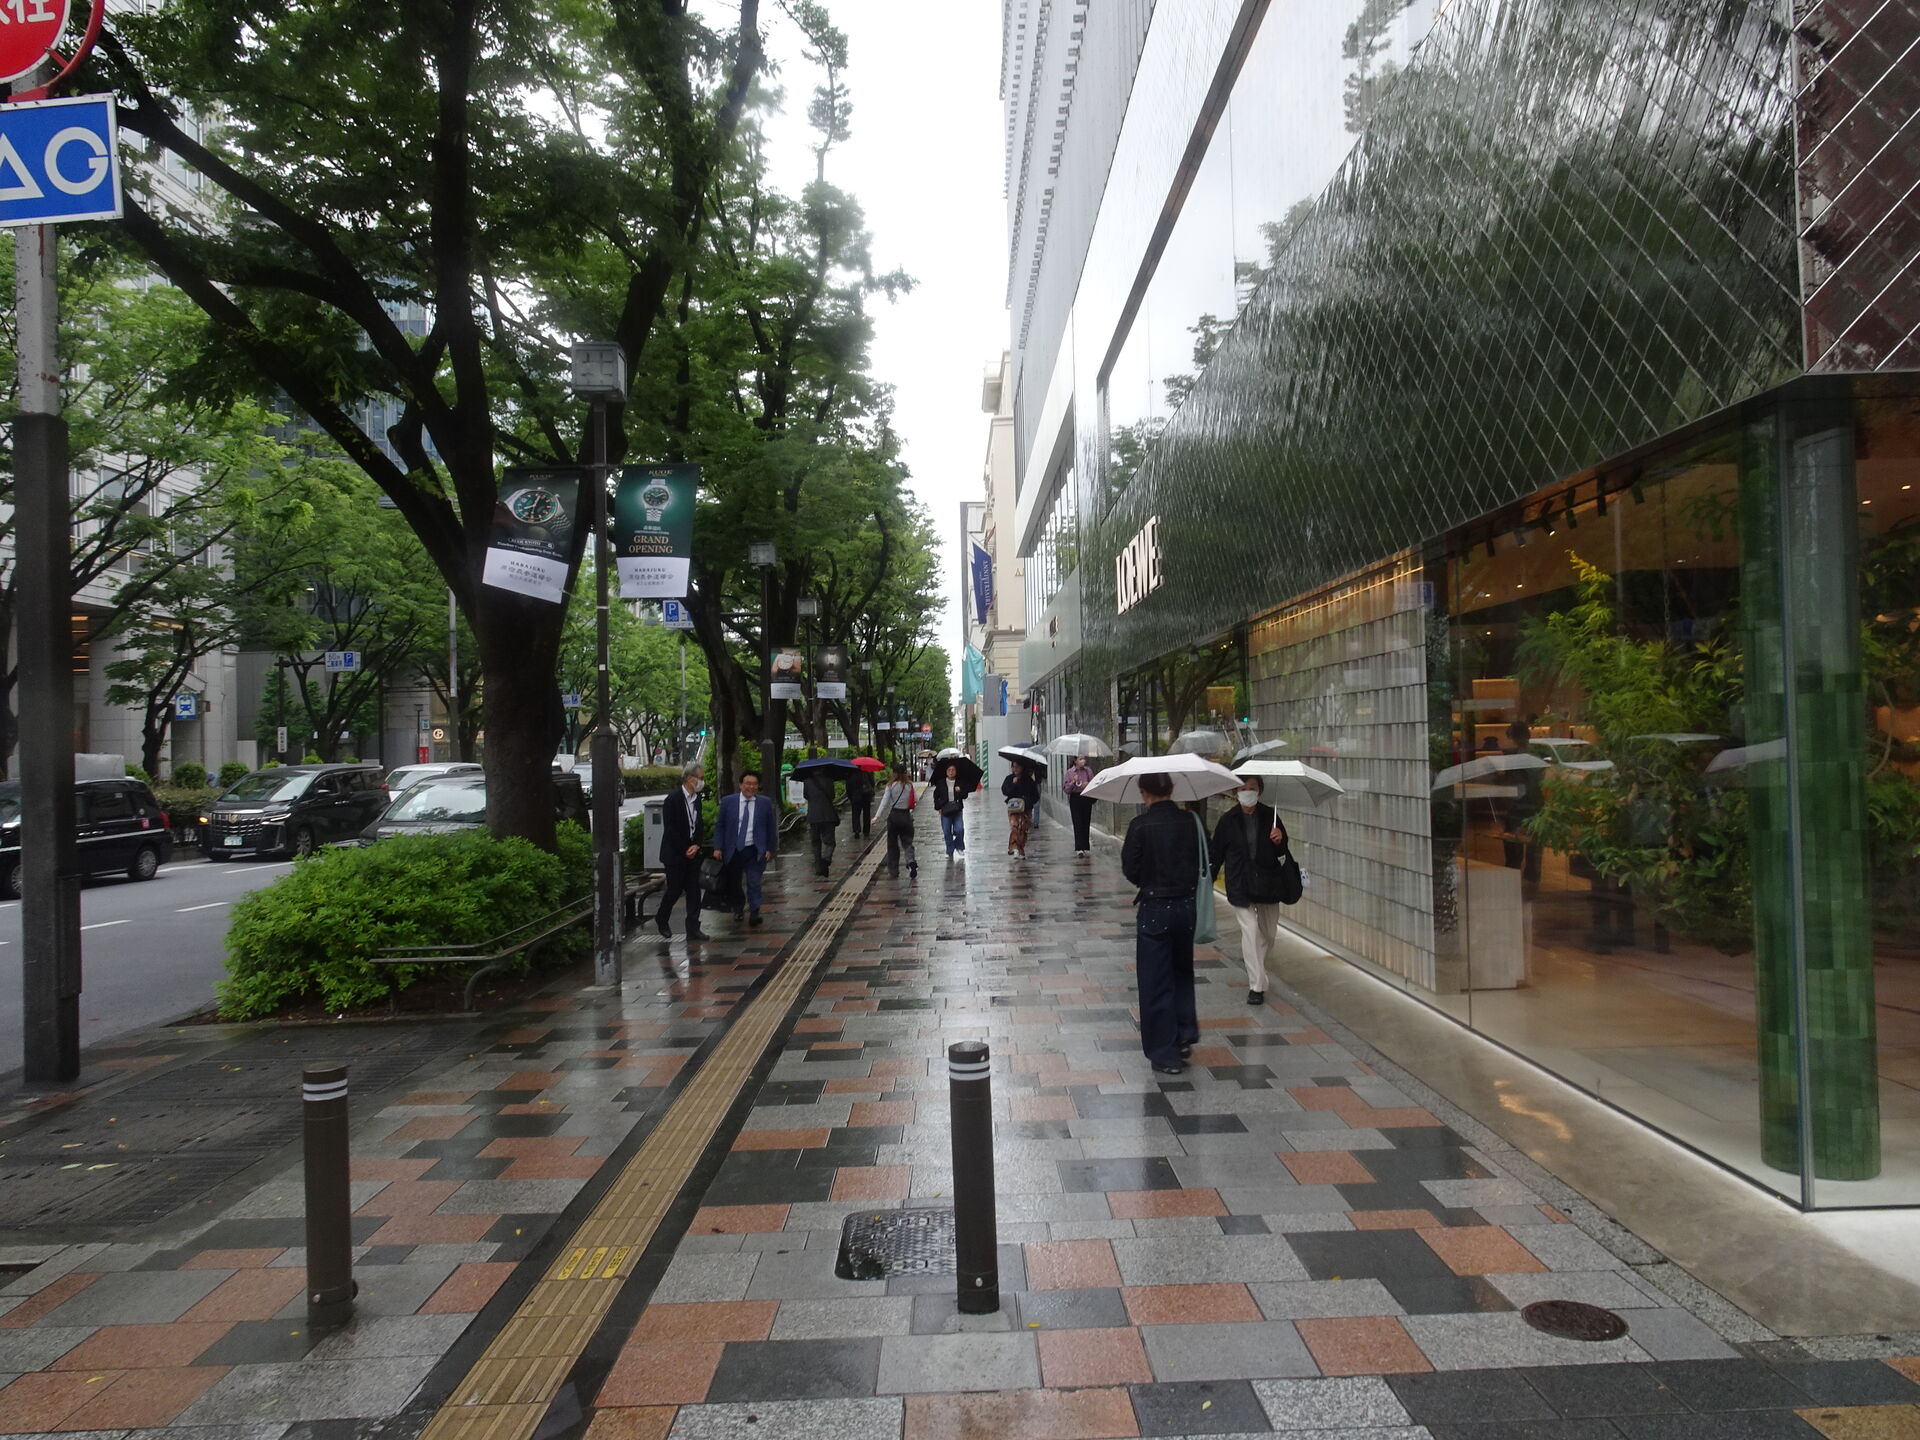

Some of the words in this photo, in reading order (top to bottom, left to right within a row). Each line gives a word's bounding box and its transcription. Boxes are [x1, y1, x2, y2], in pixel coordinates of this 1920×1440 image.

[633, 535, 669, 544] GRAND
[628, 544, 673, 554] OPENING
[1116, 516, 1160, 615] LOEWE
[668, 603, 677, 615] P
